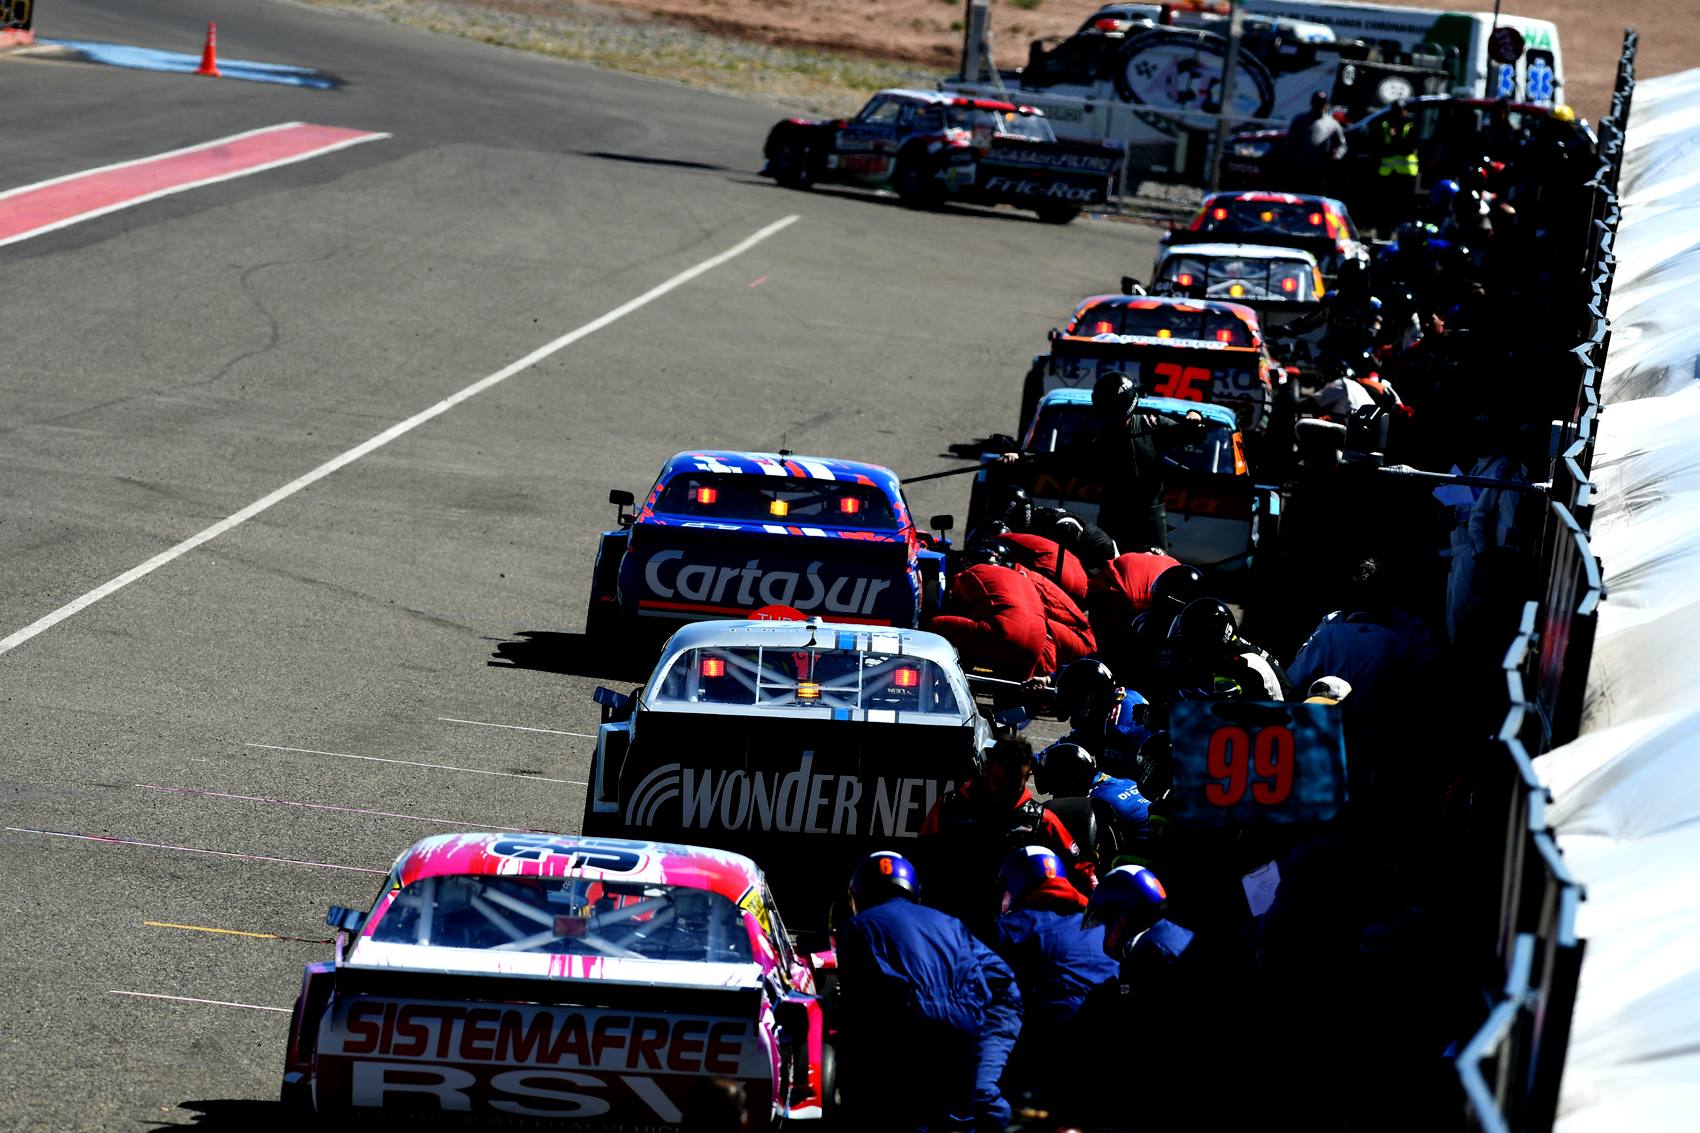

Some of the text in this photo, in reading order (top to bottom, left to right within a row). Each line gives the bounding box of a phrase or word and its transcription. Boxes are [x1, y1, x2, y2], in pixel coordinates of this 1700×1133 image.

[644, 549, 892, 615] CartaSur
[1204, 724, 1296, 808] 99
[343, 1001, 747, 1074] SISTEMAFREE
